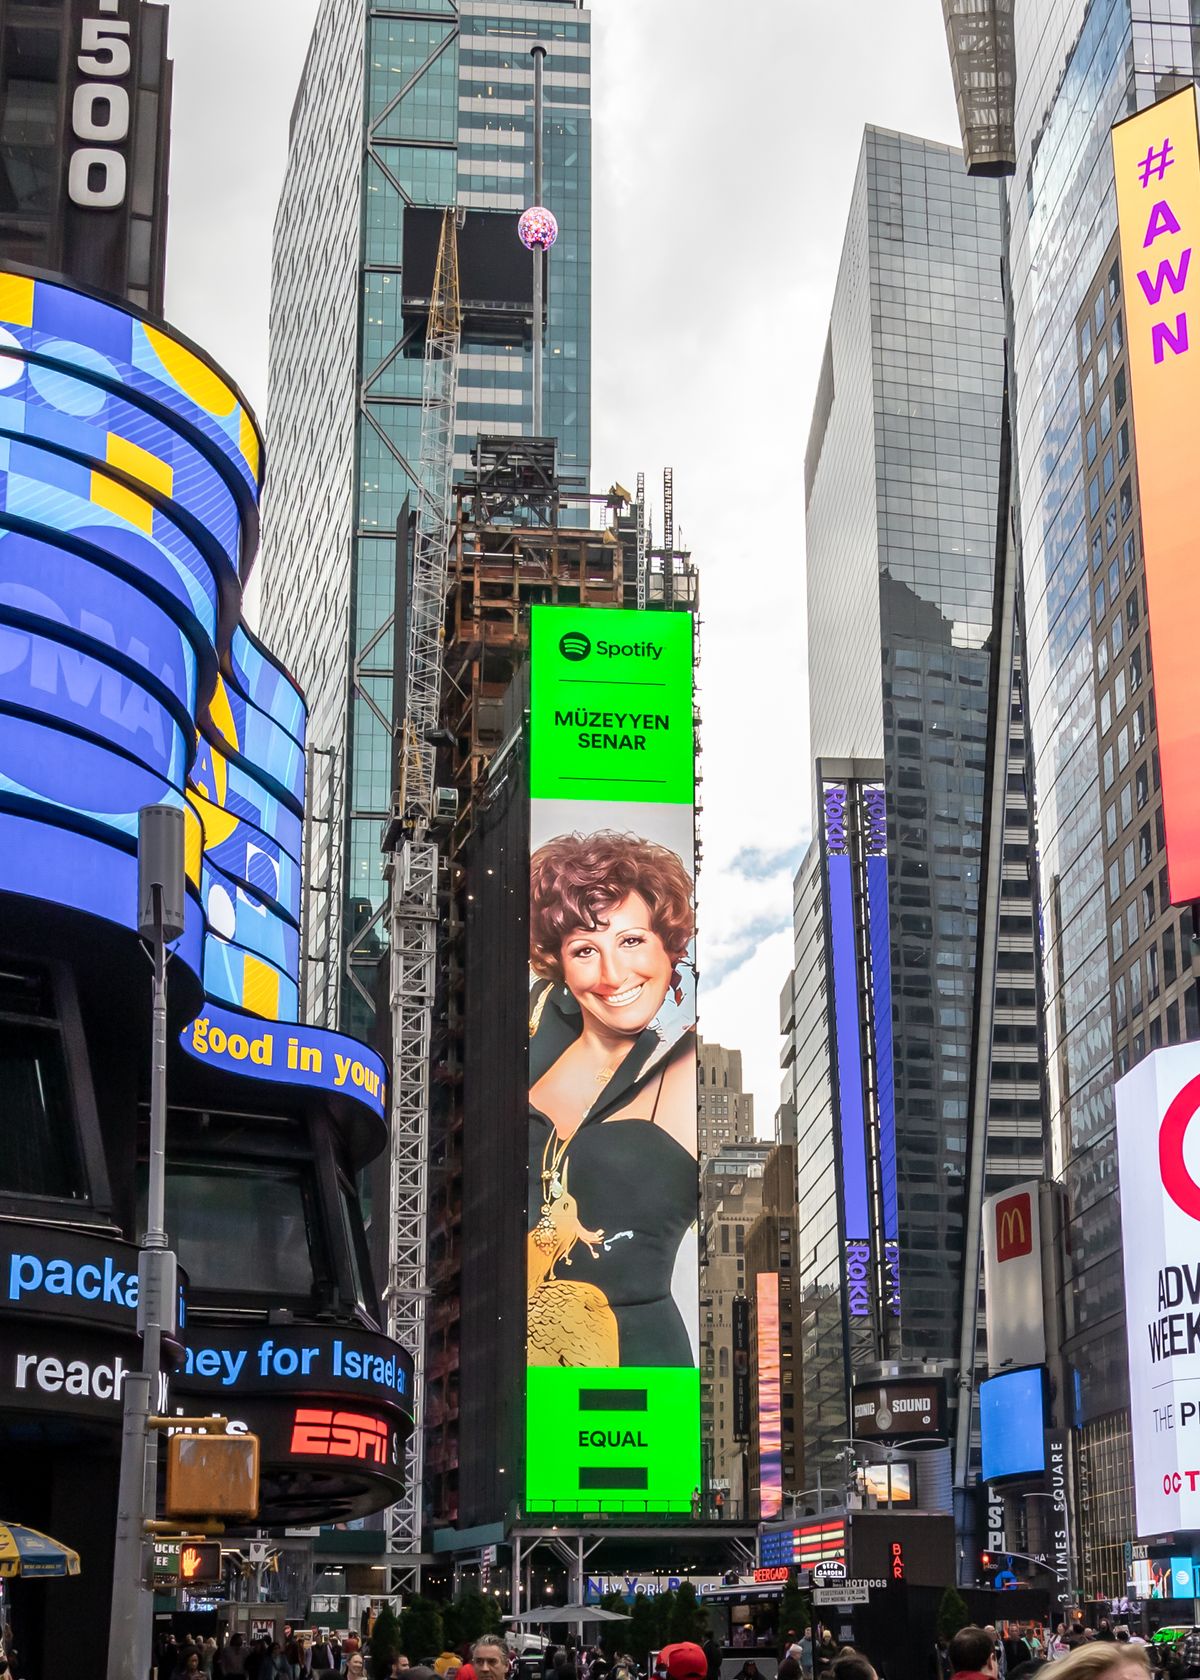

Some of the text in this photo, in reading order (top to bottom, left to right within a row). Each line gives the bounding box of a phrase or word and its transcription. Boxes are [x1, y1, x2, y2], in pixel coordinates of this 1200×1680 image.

[68, 0, 131, 208] 500
[1136, 137, 1192, 365] #AWN
[596, 639, 663, 660] Spotify
[554, 707, 670, 731] MÜZEYYEN
[577, 732, 647, 751] SENAR
[192, 1017, 274, 1066] good
[287, 1037, 323, 1073] in
[333, 1053, 380, 1098] your
[257, 1340, 320, 1376] for
[333, 1340, 397, 1390] Israel
[892, 1397, 931, 1413] SOUND
[1152, 1402, 1200, 1432] THE P
[290, 1408, 388, 1465] ESPN
[578, 1430, 648, 1448] EQUAL
[1051, 1442, 1066, 1511] SQUARE
[892, 1543, 904, 1578] BAR
[1055, 1530, 1068, 1582] TIMES
[1132, 1545, 1149, 1560] AT&T
[845, 1579, 888, 1588] HOTDOGS
